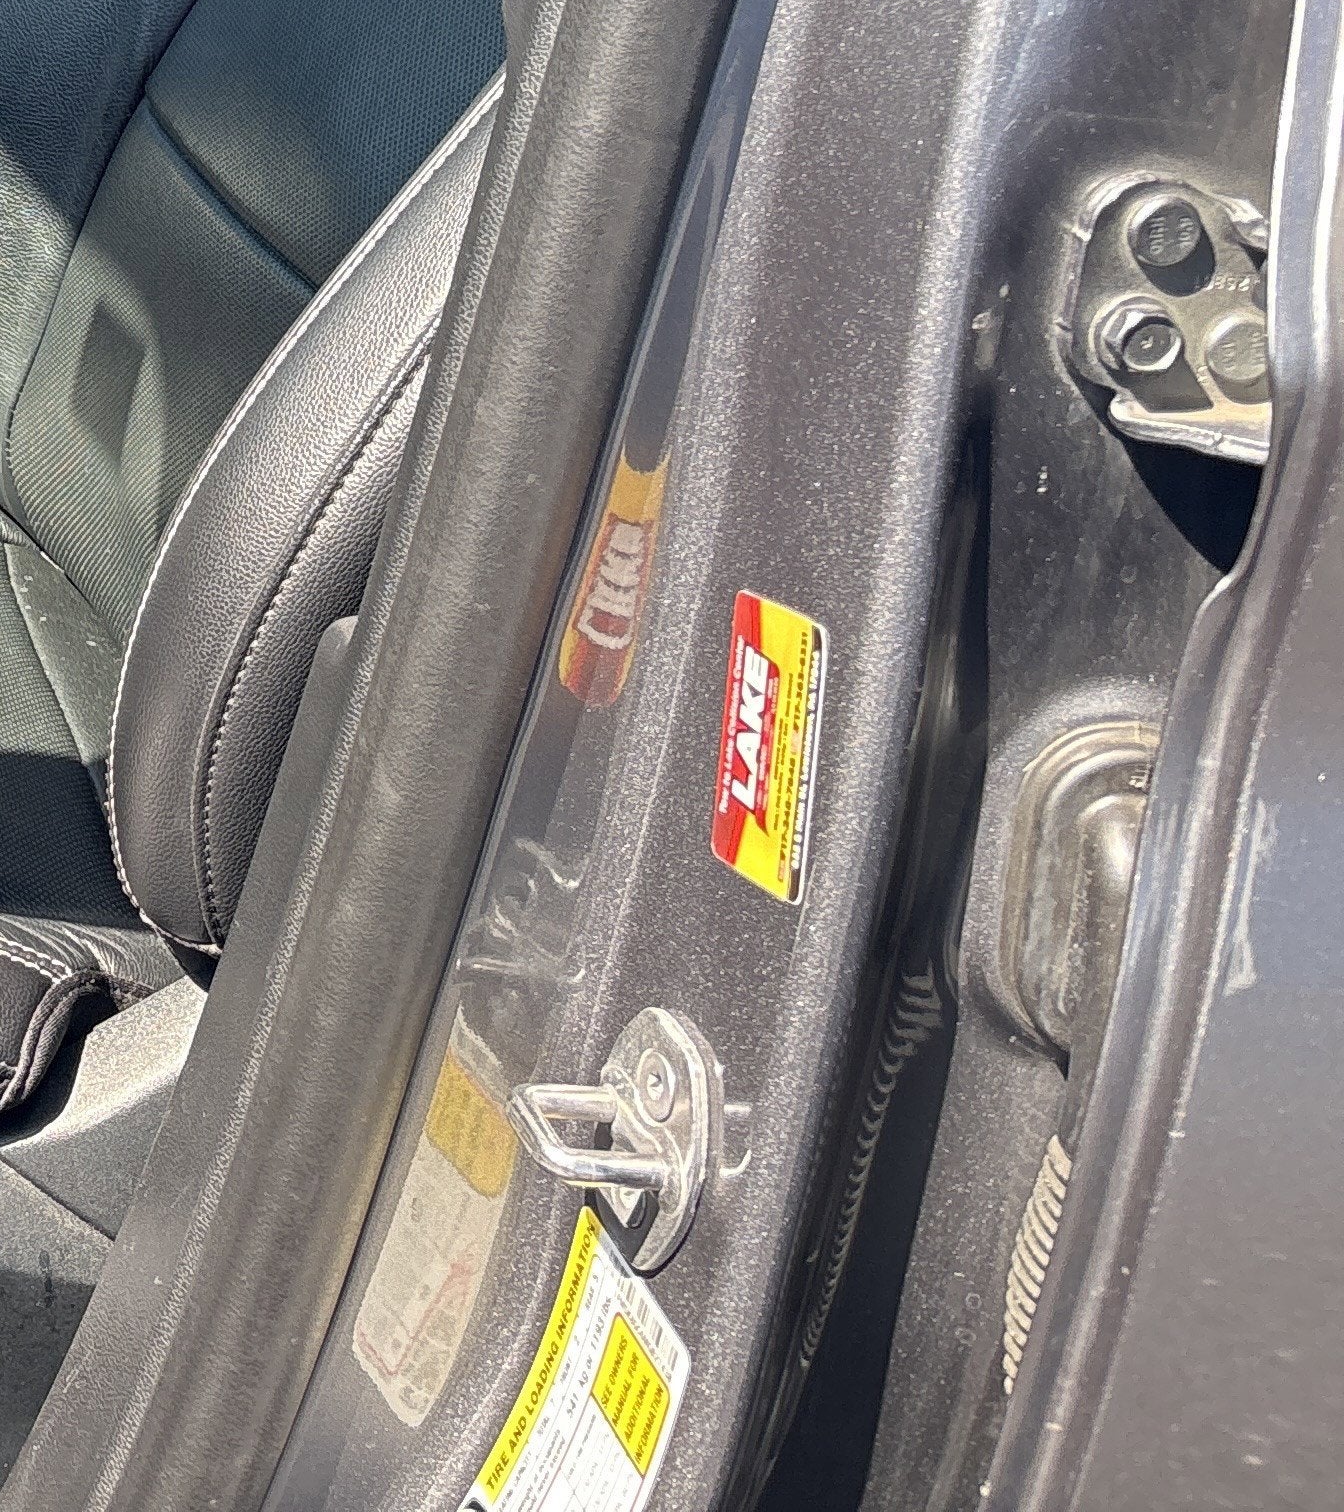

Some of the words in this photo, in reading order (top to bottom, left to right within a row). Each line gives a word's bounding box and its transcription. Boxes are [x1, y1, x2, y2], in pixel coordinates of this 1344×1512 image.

[732, 645, 770, 810] LAKE
[486, 1451, 510, 1491] TIRE
[509, 1416, 527, 1453] AND
[525, 1340, 560, 1415] LOADING
[556, 1223, 596, 1341] INFORMATION
[600, 1382, 612, 1409] SEE
[611, 1334, 628, 1383] OWNERS
[612, 1380, 632, 1427] MANUAL
[628, 1351, 641, 1379] FOR
[624, 1374, 651, 1442] ADDITIONAL
[635, 1385, 666, 1467] INFORMATION
